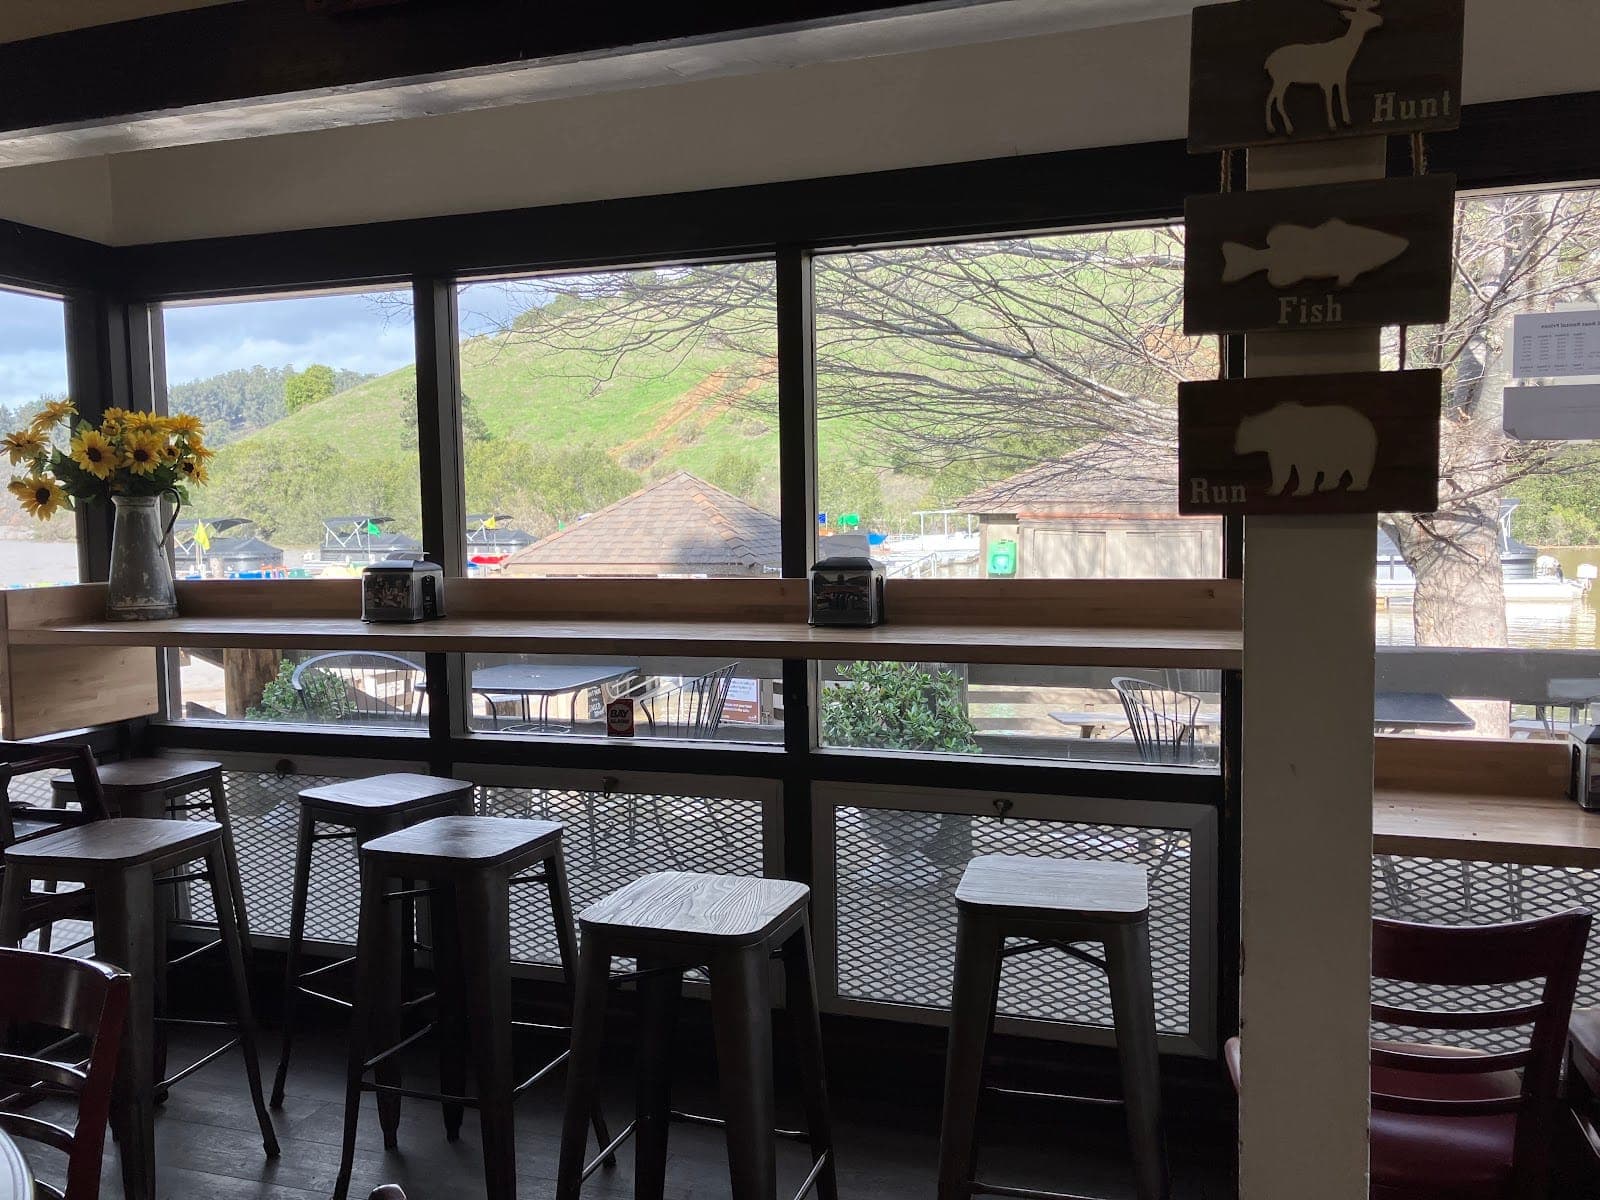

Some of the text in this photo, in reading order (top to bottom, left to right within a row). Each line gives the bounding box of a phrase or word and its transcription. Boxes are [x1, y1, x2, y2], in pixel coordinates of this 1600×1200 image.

[1372, 90, 1451, 122] Hunt
[1277, 294, 1342, 324] Fish
[1189, 477, 1247, 503] Run
[610, 709, 629, 718] BAY
